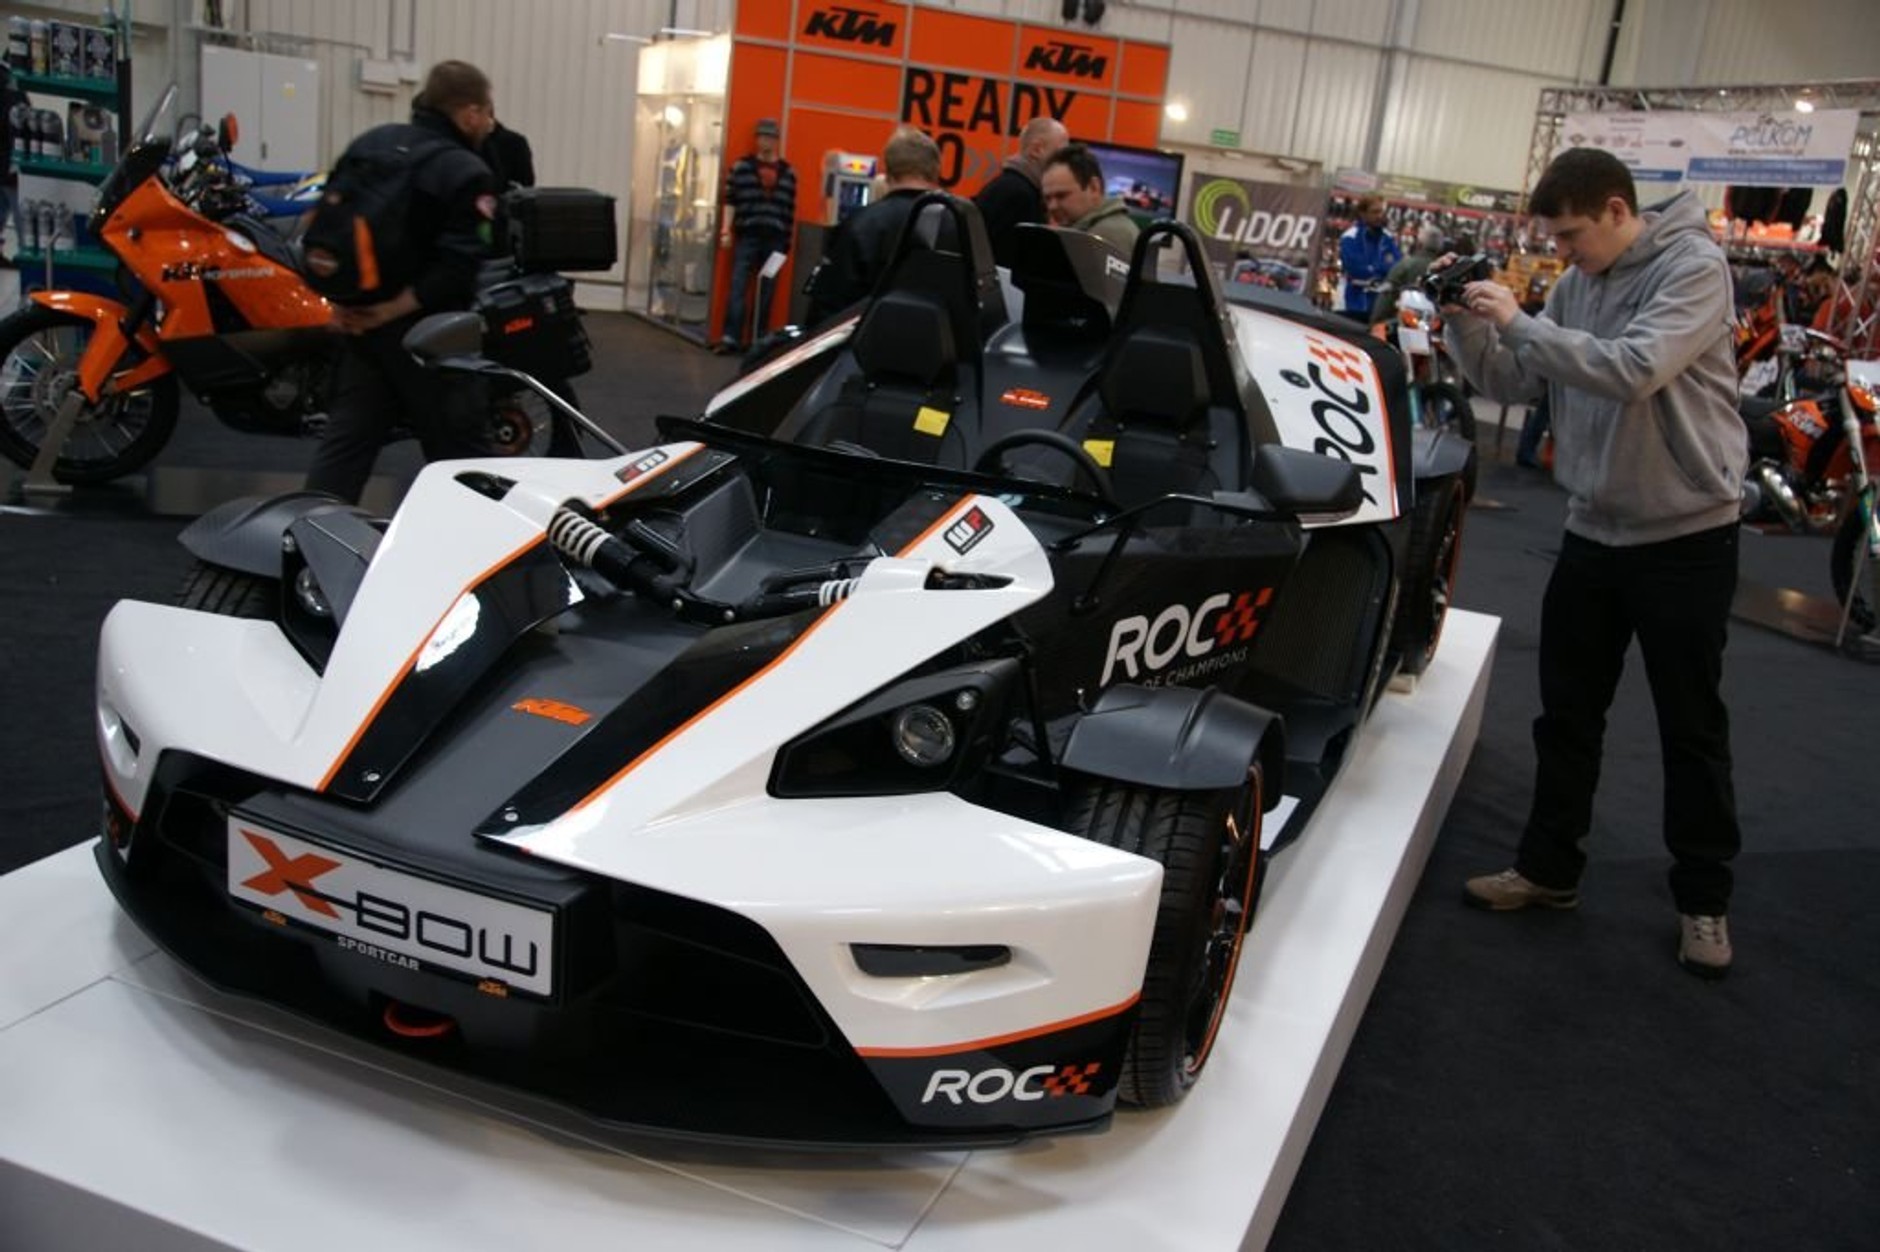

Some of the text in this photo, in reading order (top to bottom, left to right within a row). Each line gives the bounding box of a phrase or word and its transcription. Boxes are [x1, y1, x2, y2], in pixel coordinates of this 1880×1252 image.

[804, 6, 897, 47] KTM
[1025, 41, 1108, 78] KTM
[901, 66, 1077, 138] READY
[1100, 593, 1231, 687] ROC
[1165, 646, 1249, 686] CHAMPIONS
[239, 829, 537, 976] X-BOW
[338, 936, 419, 971] SPORTCAR
[922, 1065, 1055, 1104] ROC
